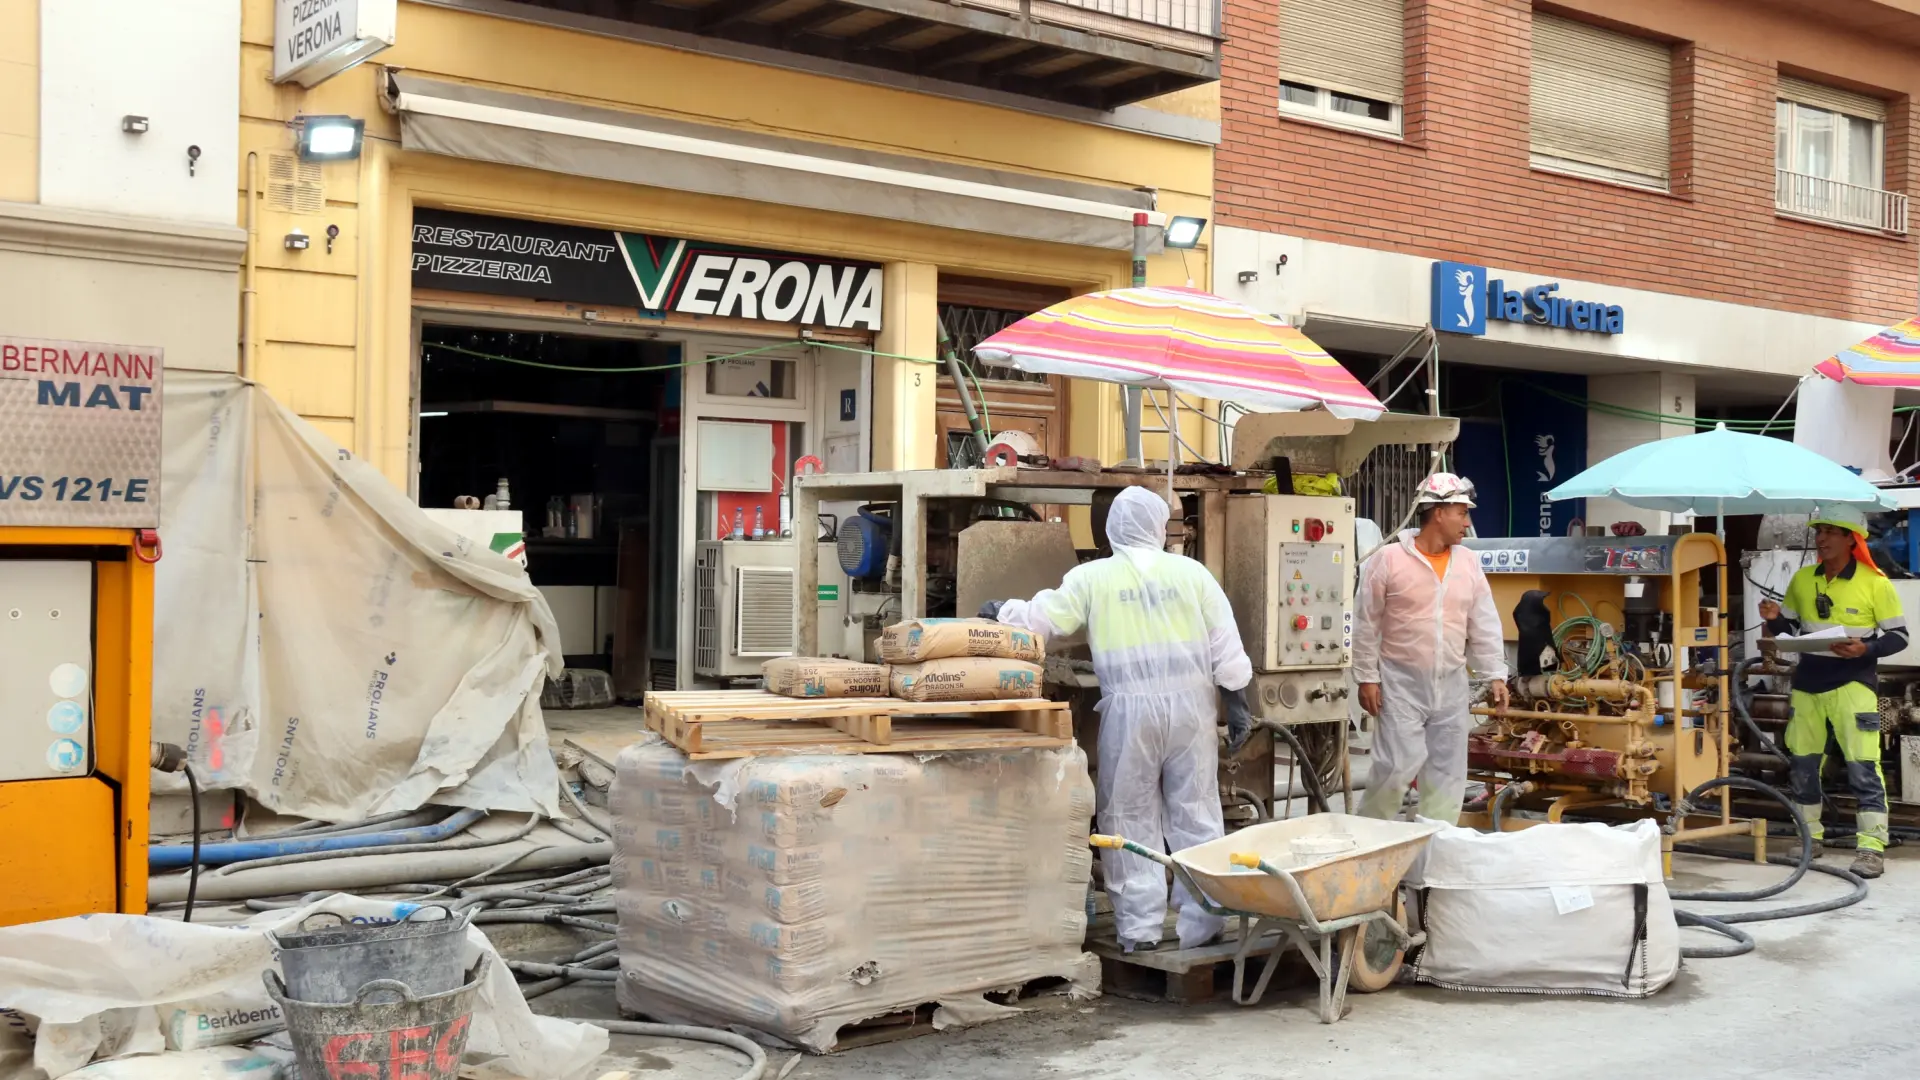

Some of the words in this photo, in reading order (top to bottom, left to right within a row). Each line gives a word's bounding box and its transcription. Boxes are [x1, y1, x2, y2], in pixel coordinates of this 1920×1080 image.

[292, 0, 338, 27] PIZZER
[288, 11, 342, 63] VERONA
[412, 224, 615, 263] RESTAURANT
[411, 252, 552, 284] PIZZERIA
[613, 231, 883, 331] VERONA
[1488, 278, 1524, 321] la
[1525, 281, 1625, 335] Sirena
[913, 372, 922, 387] 3
[37, 379, 153, 411] MAT
[845, 397, 852, 414] R
[1674, 395, 1683, 413] 5
[51, 476, 149, 503] 121-E
[968, 628, 1000, 639] Molins
[849, 684, 881, 693] Molins
[925, 672, 961, 684] Molins
[925, 682, 955, 691] DRAGON
[365, 670, 389, 741] PROLIANS
[271, 716, 300, 787] PROLIANS
[197, 1004, 281, 1031] Berkbent
